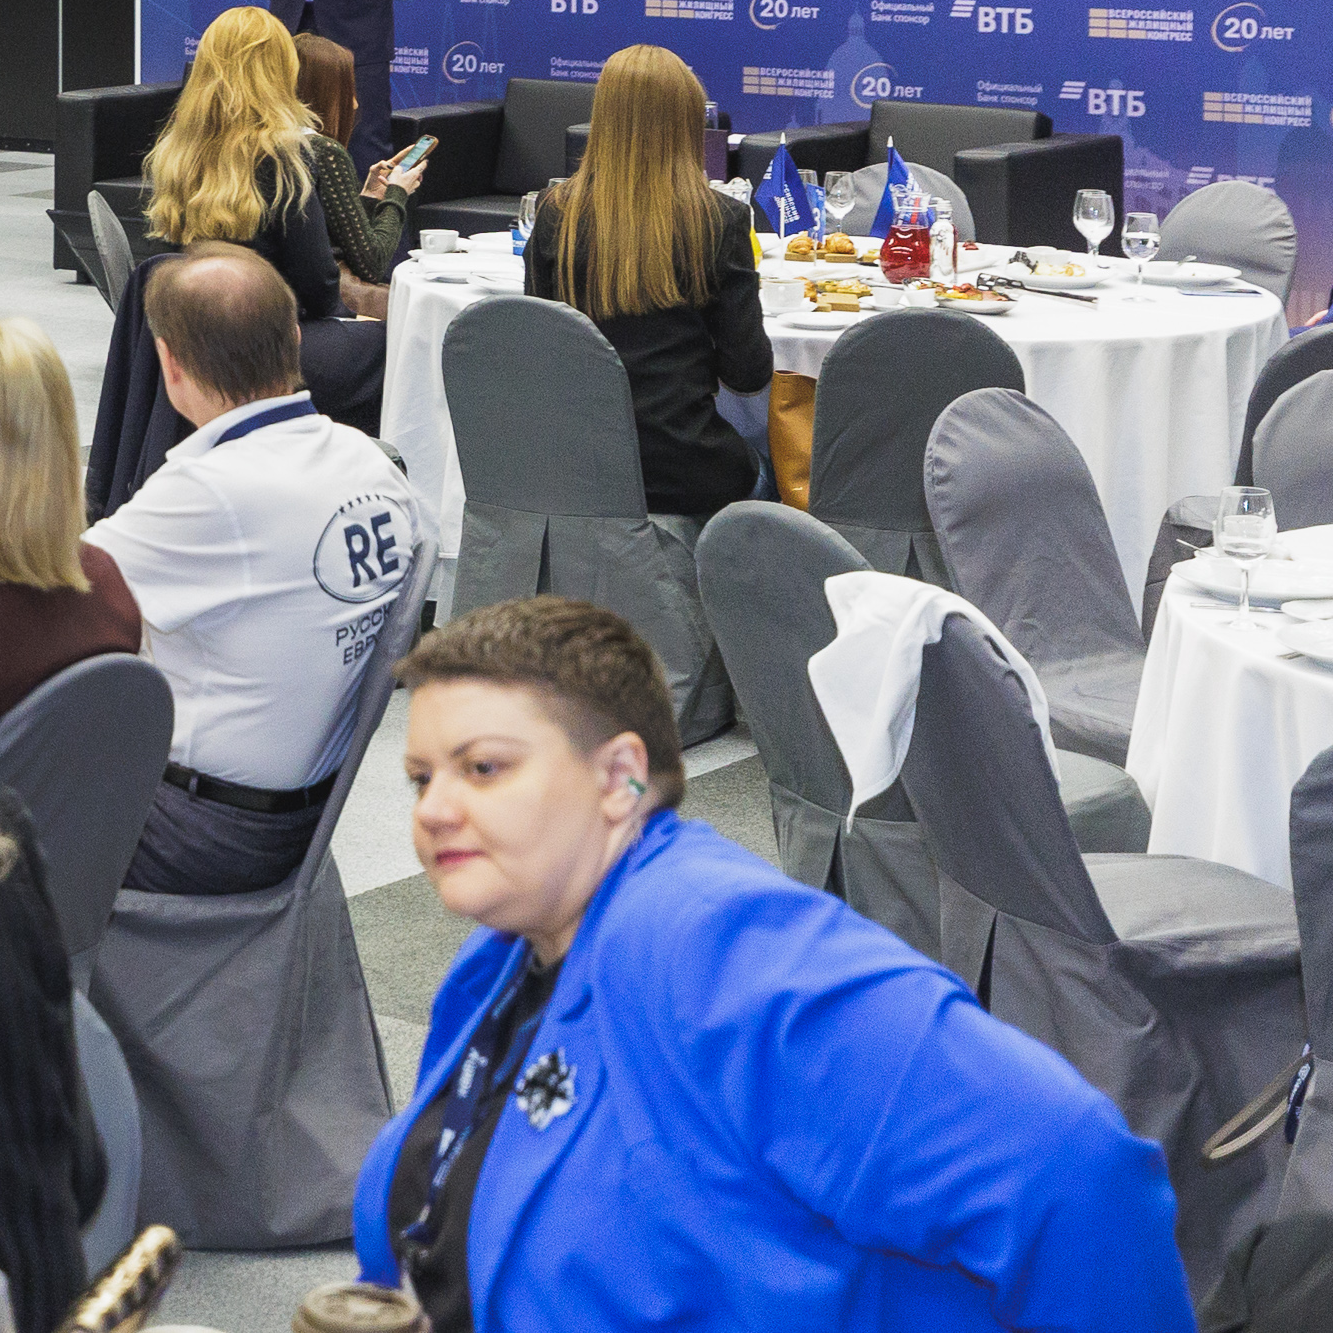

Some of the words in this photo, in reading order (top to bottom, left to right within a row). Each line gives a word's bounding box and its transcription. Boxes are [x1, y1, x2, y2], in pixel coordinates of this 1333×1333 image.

[791, 6, 819, 19] лет
[978, 6, 1033, 34] ВТБ
[1108, 9, 1193, 20] ВСЕРОССИЙСКИЙ
[1128, 19, 1193, 31] ЖИЛИЩНЫЙ
[1147, 30, 1192, 41] КОНГРЕСС
[1224, 18, 1257, 38] 20
[1259, 26, 1295, 40] лет
[452, 54, 477, 72] 20
[479, 61, 505, 74] лет
[862, 76, 890, 96] 20
[894, 85, 923, 98] лет
[1088, 88, 1146, 117] ВТБ
[343, 511, 399, 588] RE
[335, 605, 394, 648] РУССК
